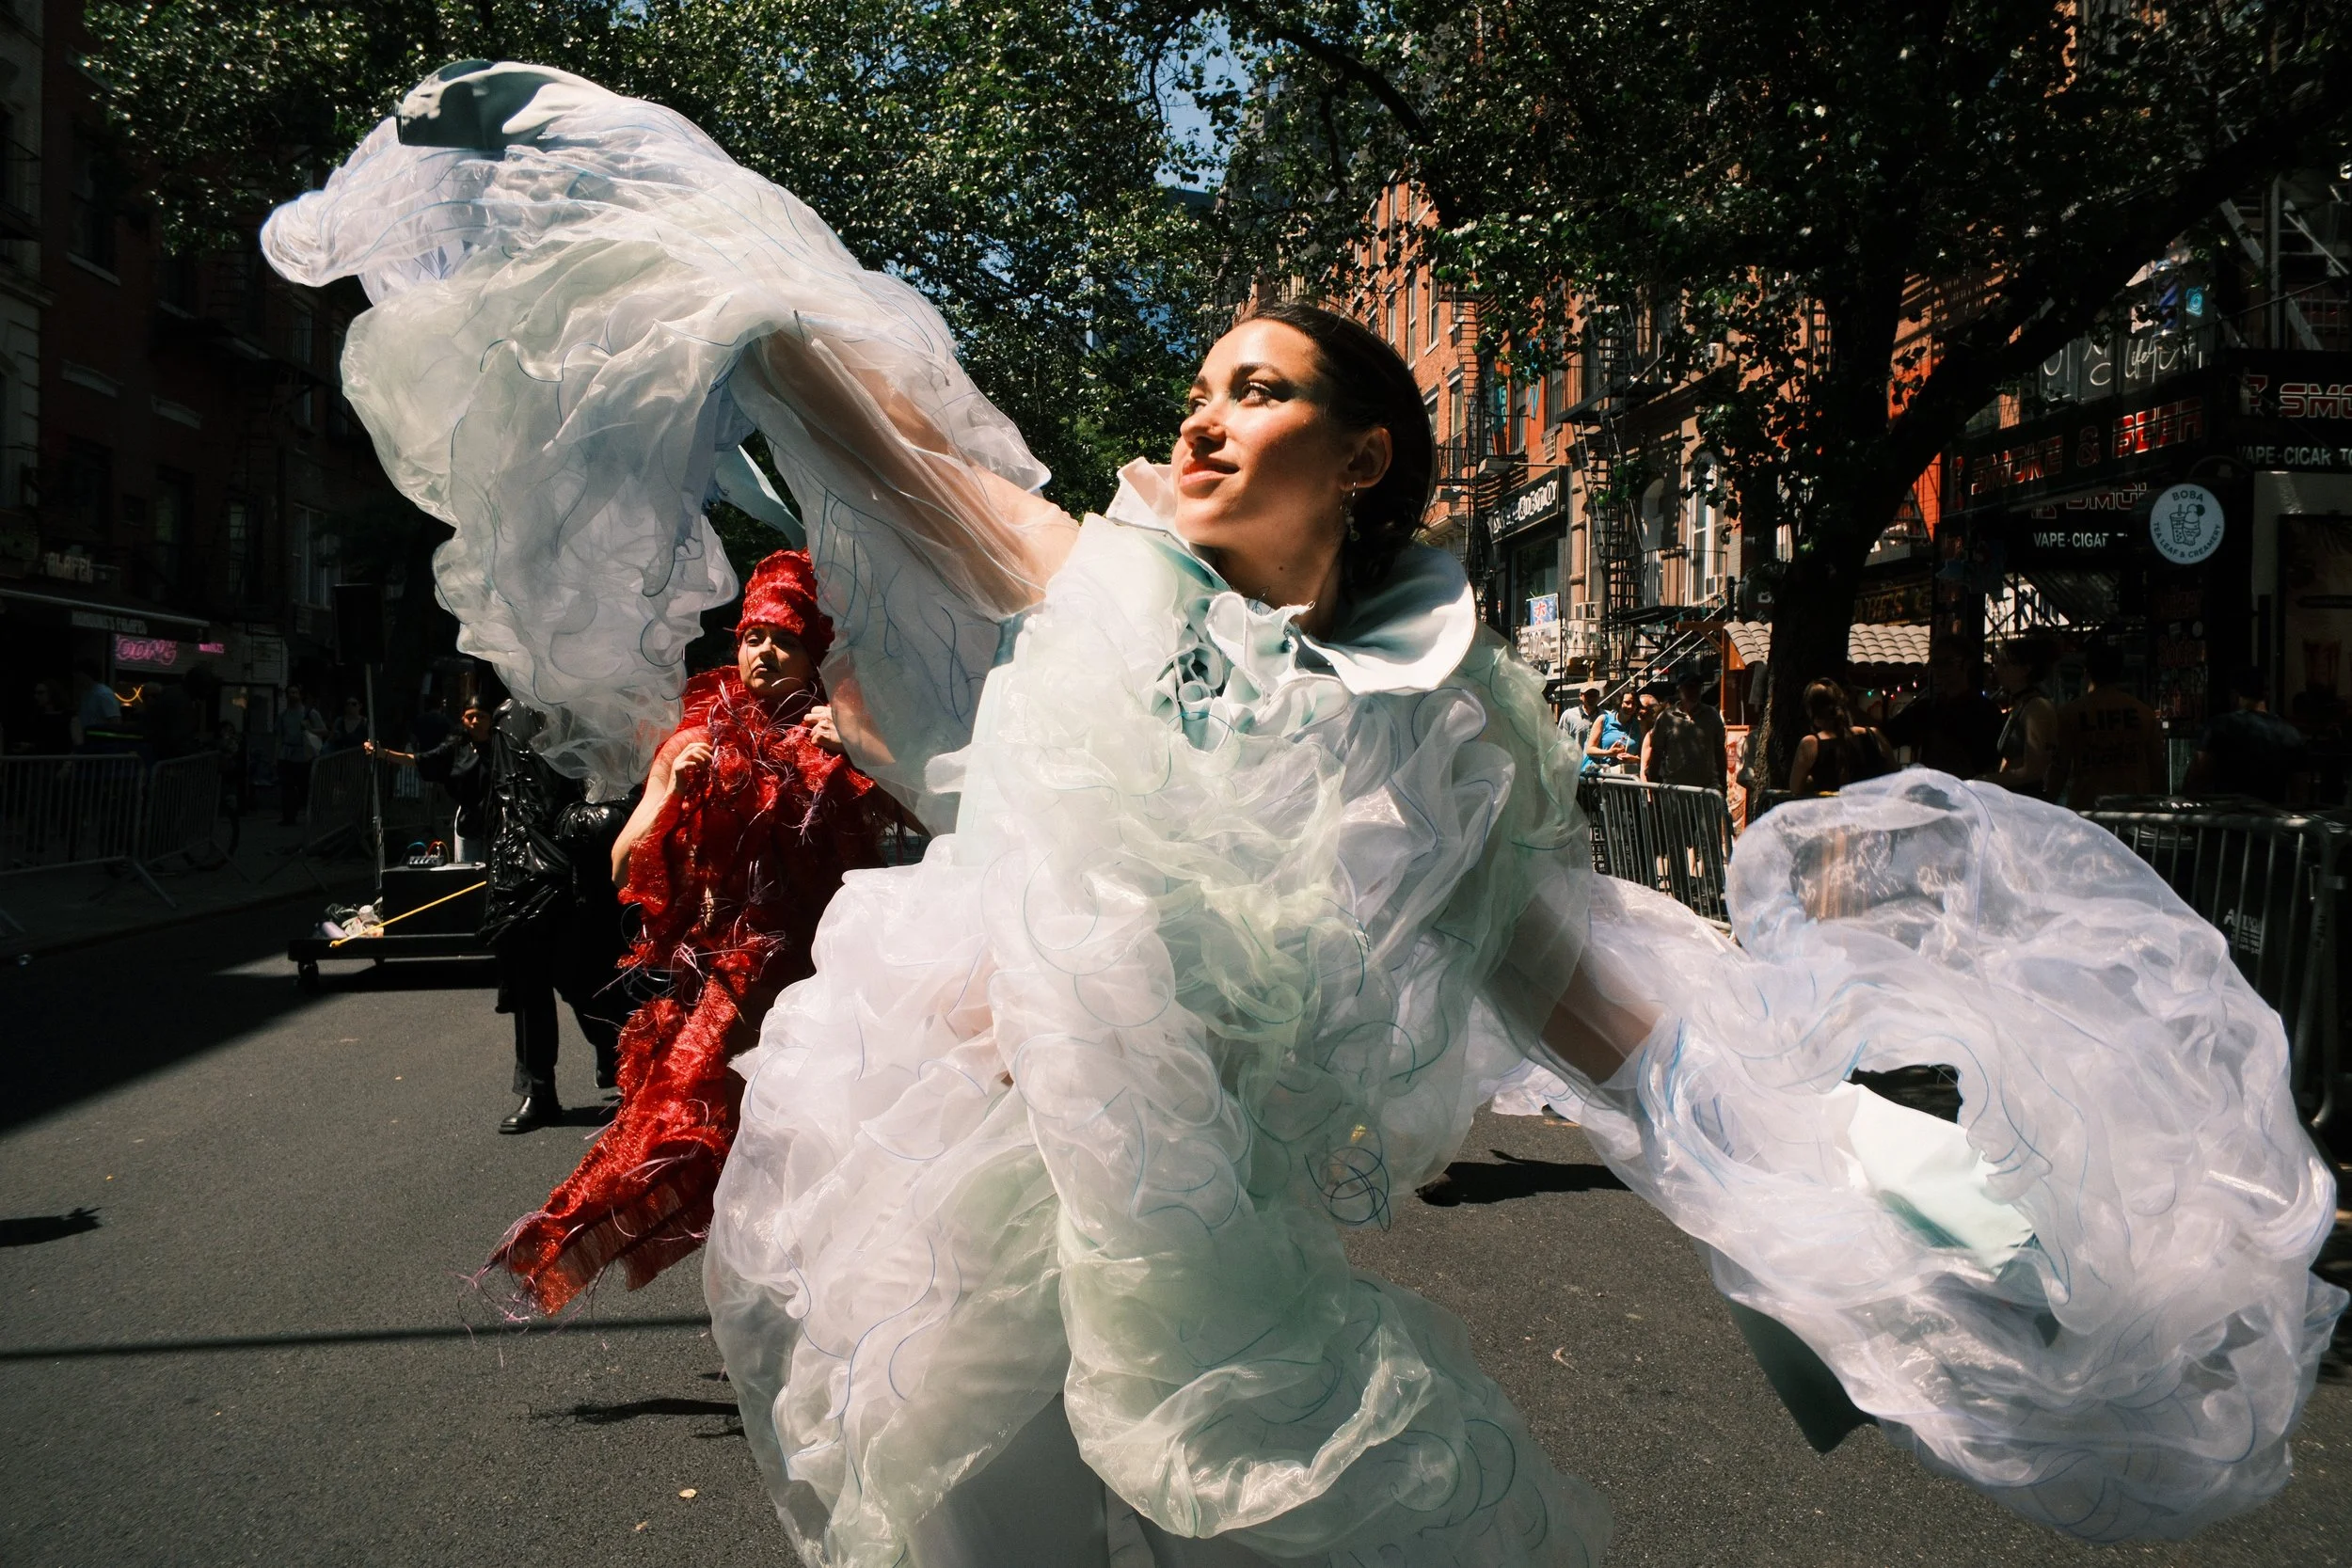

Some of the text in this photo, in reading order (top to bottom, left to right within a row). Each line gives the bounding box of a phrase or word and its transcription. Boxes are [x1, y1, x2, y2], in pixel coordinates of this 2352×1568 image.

[1971, 435, 2063, 496] SMOKE
[2111, 397, 2203, 460] BEER
[2171, 490, 2203, 501] BOBA
[2153, 521, 2162, 539] TEA
[2159, 540, 2179, 556] LEAF
[2188, 524, 2221, 558] CREAMERY
[2077, 708, 2140, 732] LIFE
